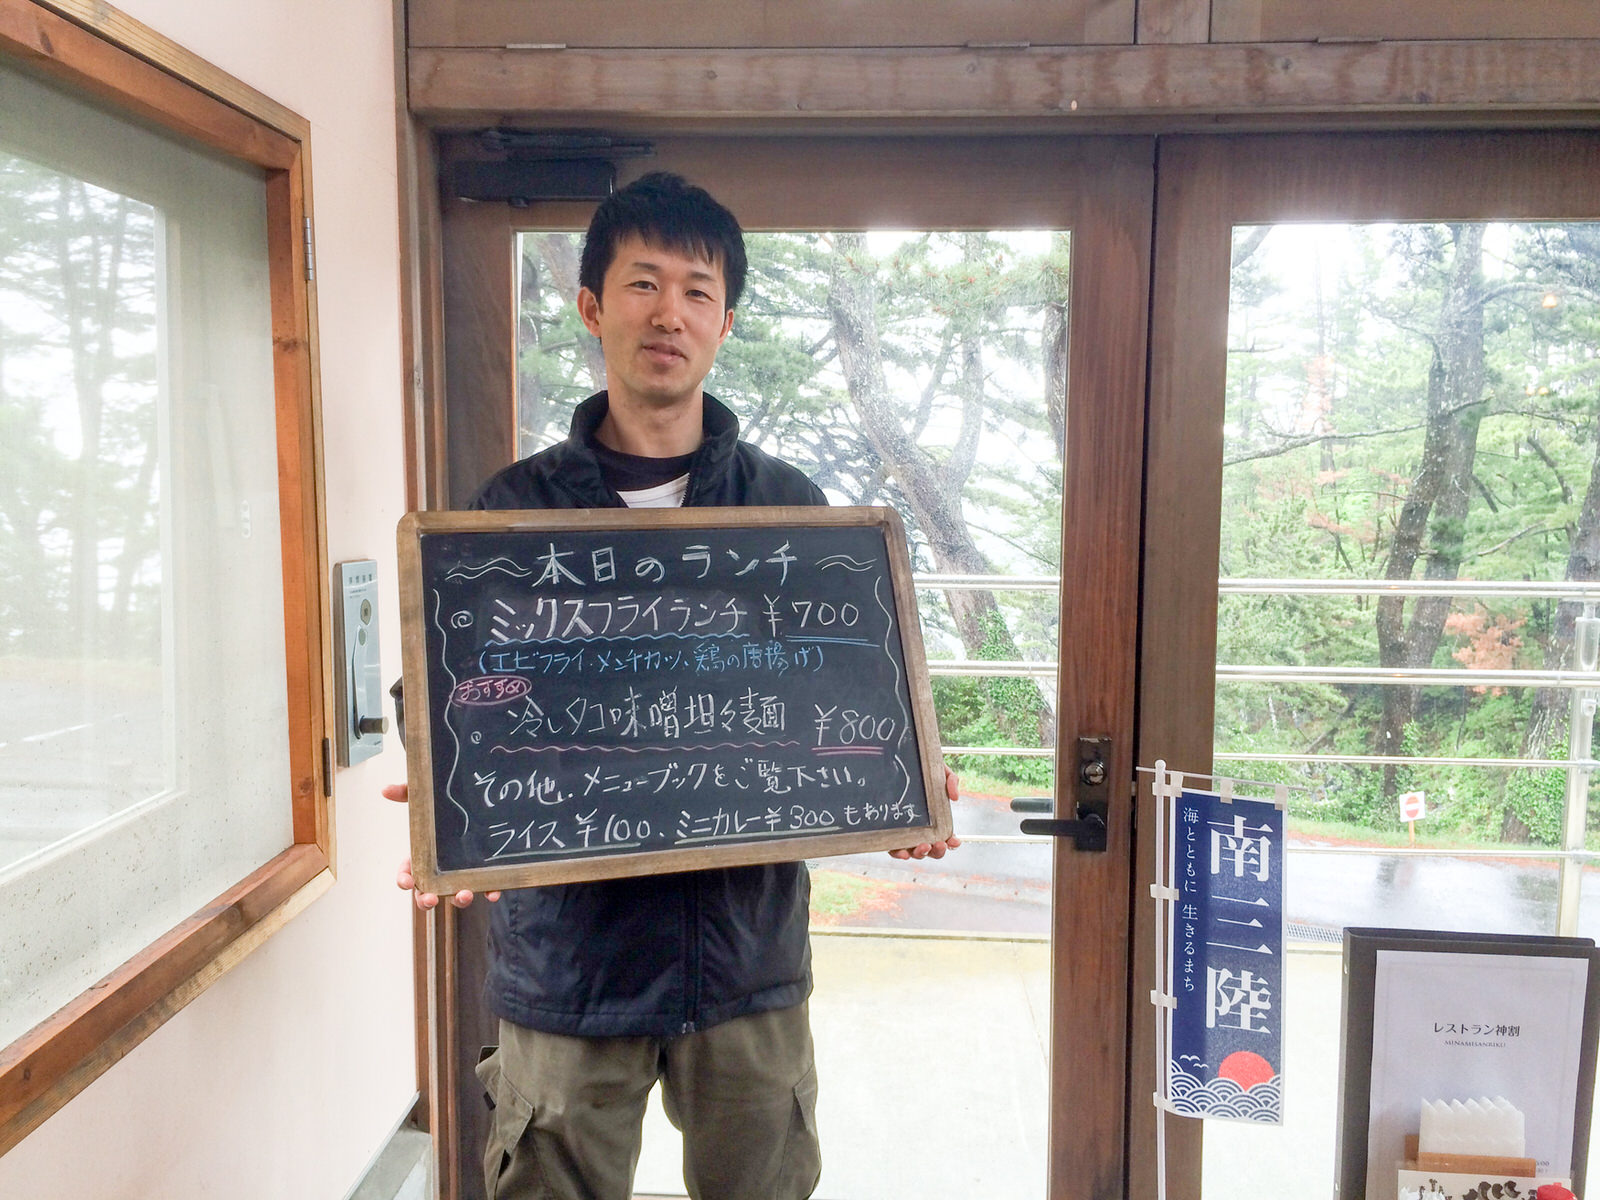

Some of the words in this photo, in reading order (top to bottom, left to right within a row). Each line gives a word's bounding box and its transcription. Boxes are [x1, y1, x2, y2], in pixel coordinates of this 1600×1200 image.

[532, 540, 797, 587] 本日のランチ
[491, 597, 747, 642] ミックスフライランチ
[763, 594, 859, 637] ¥700
[458, 679, 527, 702] おすすめ
[814, 704, 896, 745] ¥800
[1183, 807, 1199, 893] 海とともに
[1206, 814, 1273, 1034] 南三陸
[1182, 904, 1199, 992] 生きるまち
[1433, 1022, 1521, 1037] レストラン神割
